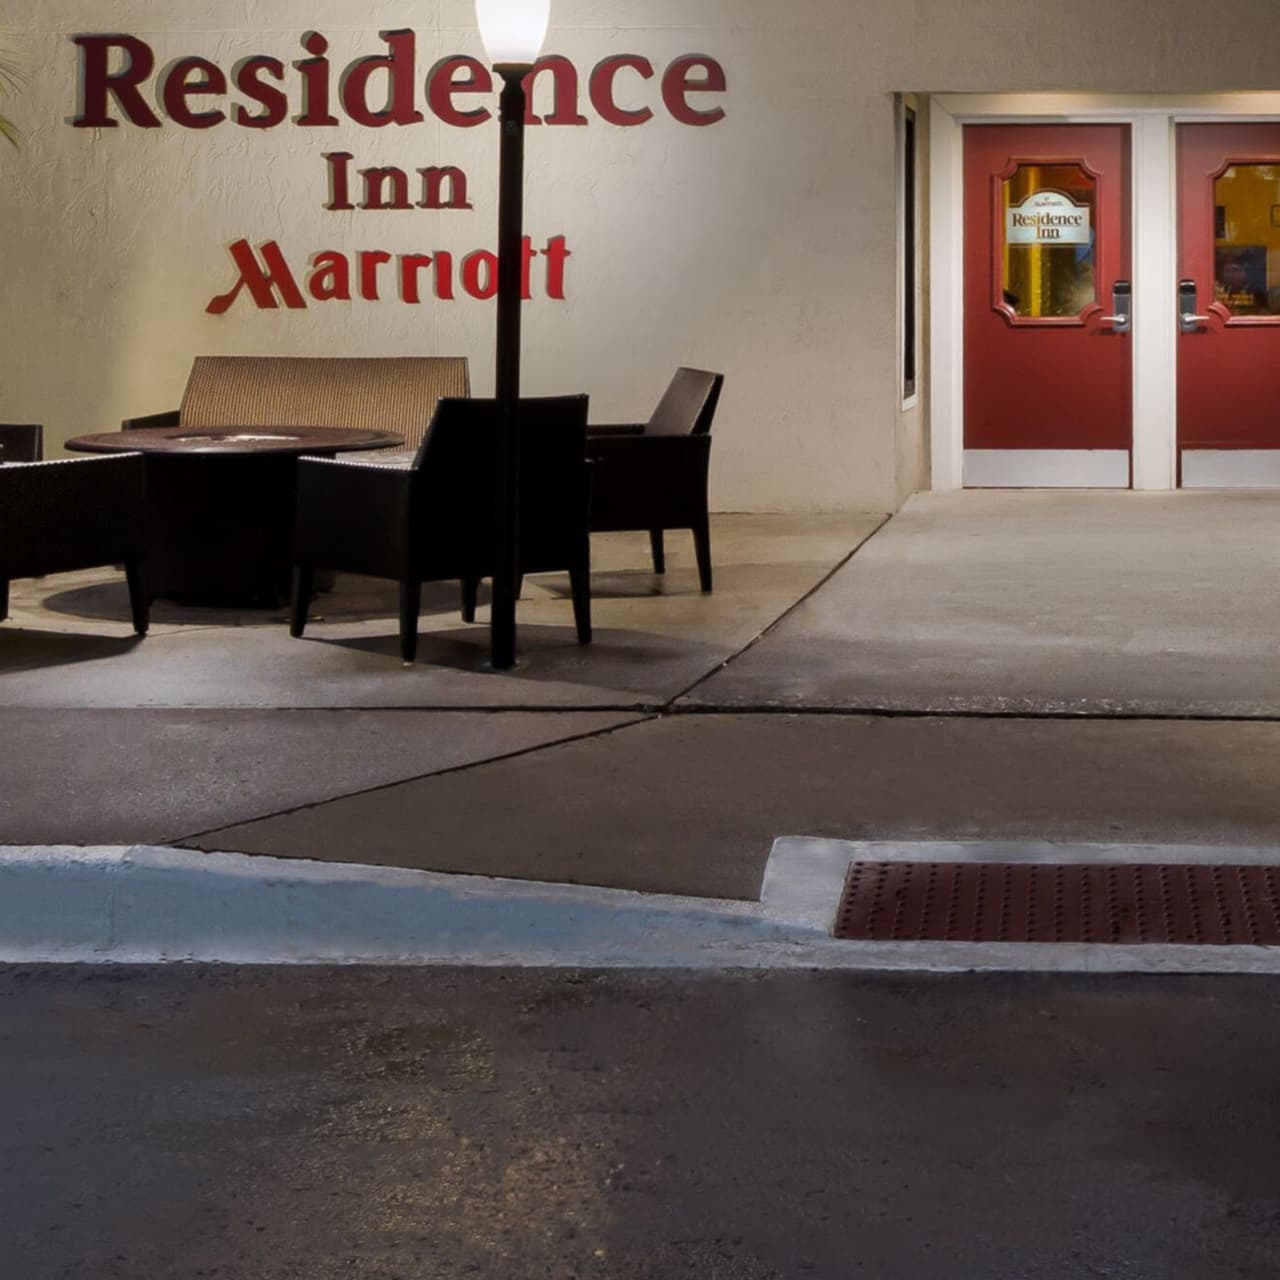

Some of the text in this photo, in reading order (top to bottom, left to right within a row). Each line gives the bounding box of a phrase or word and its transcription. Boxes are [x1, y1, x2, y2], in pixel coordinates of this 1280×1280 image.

[71, 28, 727, 128] Residence
[323, 151, 472, 210] Inn
[1012, 212, 1083, 227] Residence
[1036, 226, 1060, 240] Inn
